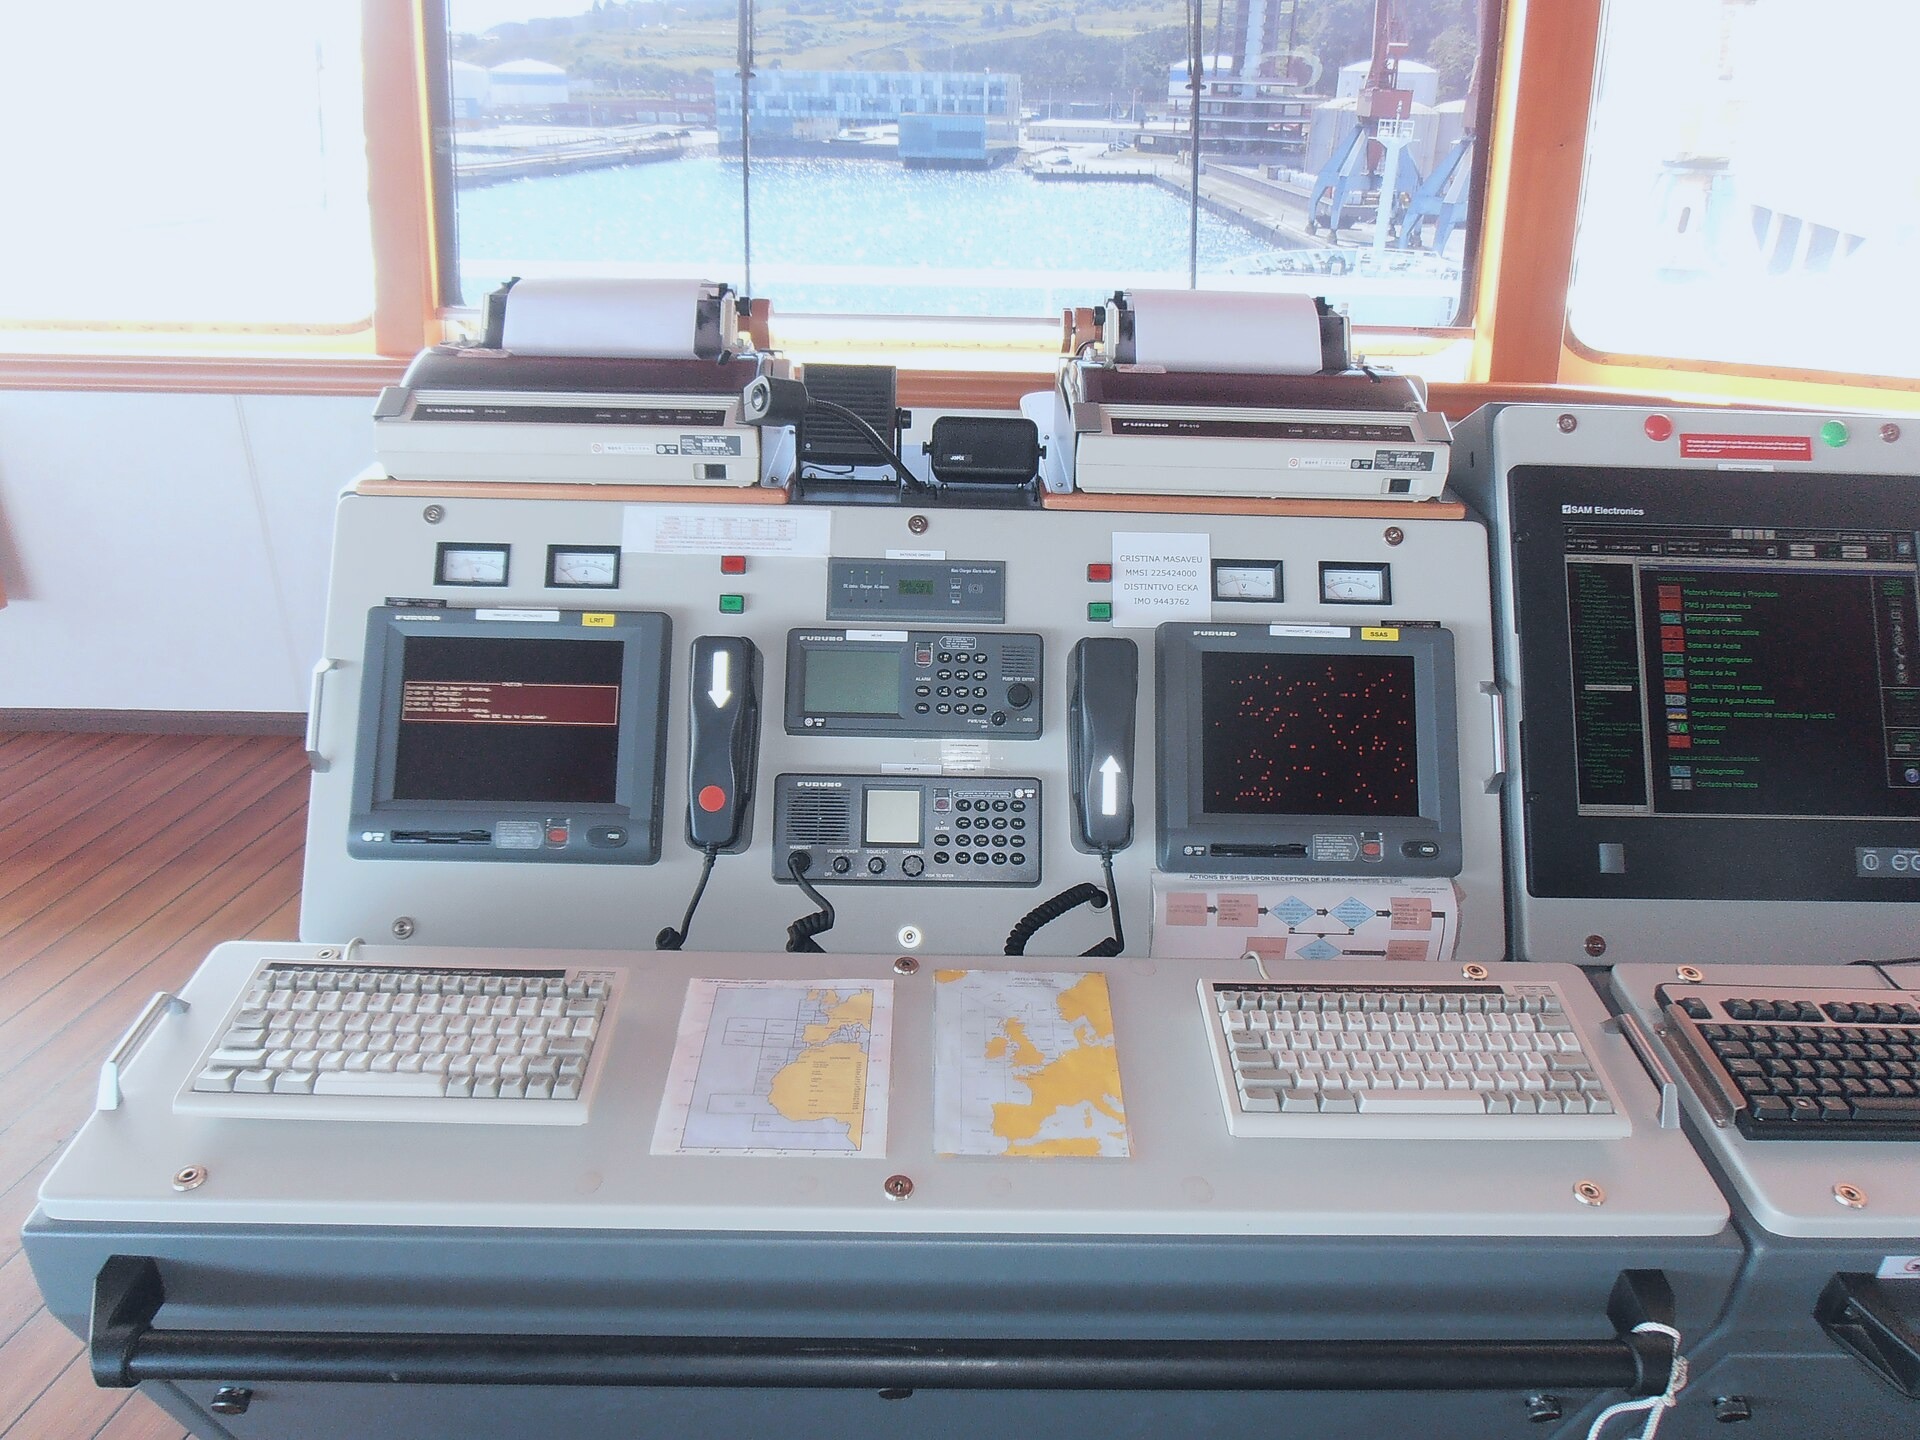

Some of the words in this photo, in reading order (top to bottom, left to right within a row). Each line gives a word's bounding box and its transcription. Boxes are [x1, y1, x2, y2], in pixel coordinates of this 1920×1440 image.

[1571, 505, 1593, 514] SAM
[1594, 506, 1645, 516] Electronics
[1119, 554, 1160, 563] CRISTINA
[1162, 555, 1203, 564] MASAVEU
[1125, 569, 1148, 577] MMSI
[1150, 569, 1197, 578] 225424000
[1123, 583, 1174, 591] DISTINTIVO
[1176, 584, 1199, 592] ECKA
[1134, 597, 1151, 605] IMO
[1153, 597, 1190, 606] 9443762
[1686, 628, 1710, 636] Sistema
[1721, 629, 1760, 637] Combustible
[1733, 781, 1758, 789] horarios
